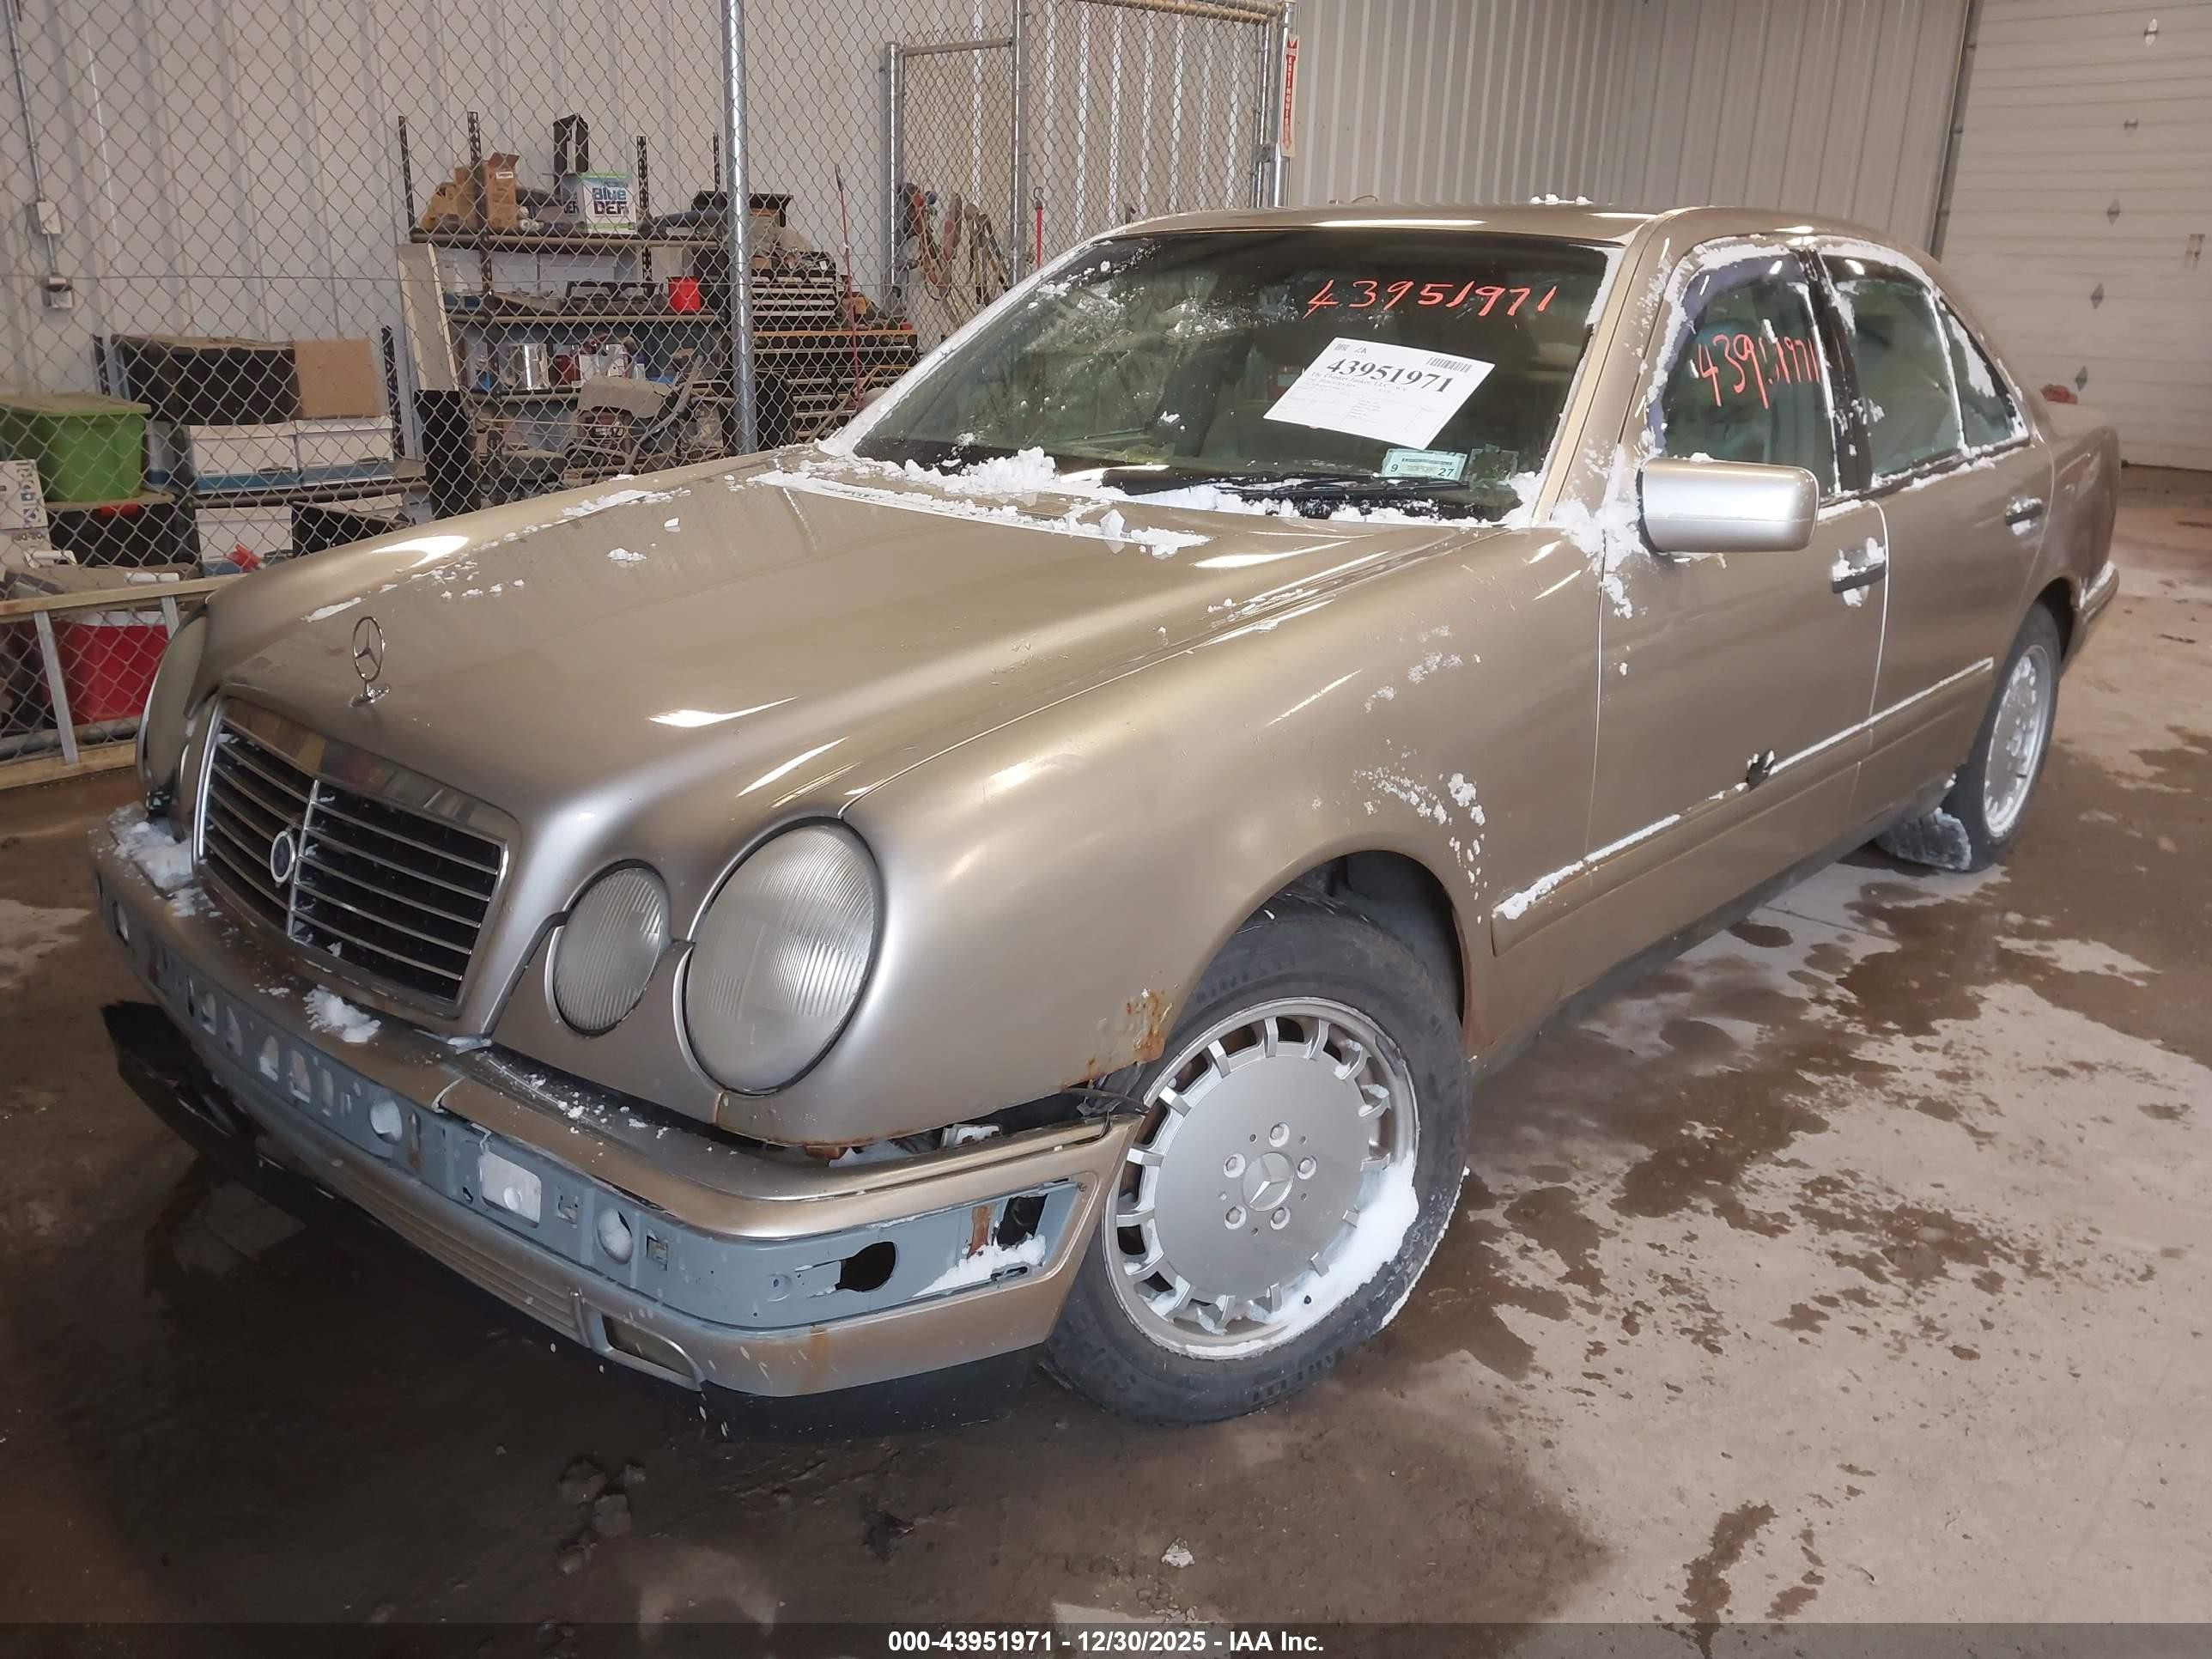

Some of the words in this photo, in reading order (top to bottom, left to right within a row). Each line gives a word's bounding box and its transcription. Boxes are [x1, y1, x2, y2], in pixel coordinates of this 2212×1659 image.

[592, 187, 627, 200] Blue
[593, 200, 628, 215] DEF
[1302, 278, 1558, 319] 43951971
[1327, 358, 1455, 393] 43951971
[1390, 464, 1399, 472] 9
[1438, 467, 1455, 477] 27
